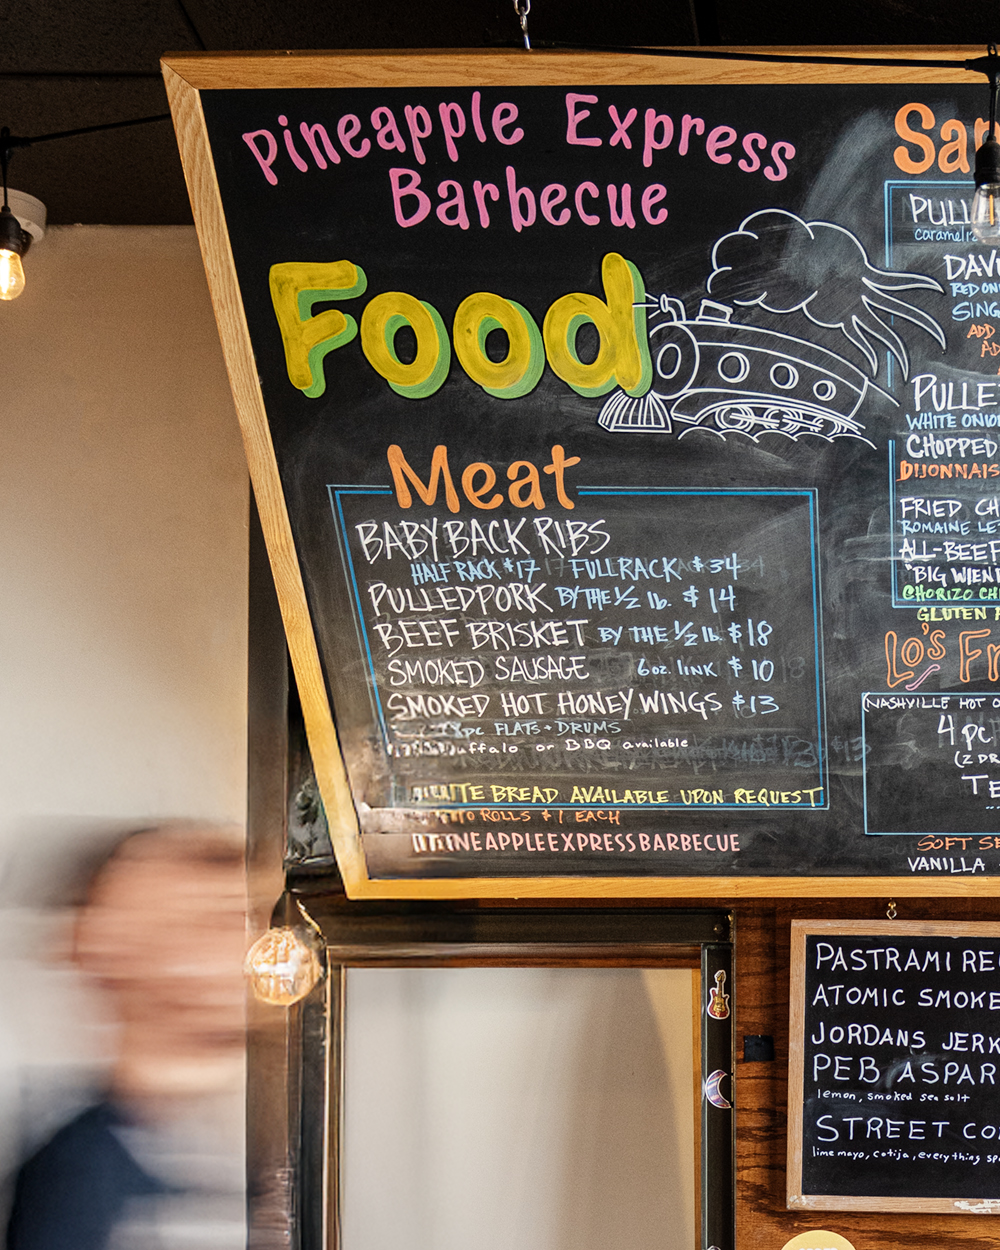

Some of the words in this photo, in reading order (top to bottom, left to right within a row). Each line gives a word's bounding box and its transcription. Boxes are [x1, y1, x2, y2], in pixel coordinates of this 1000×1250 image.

[242, 91, 525, 185] Pineapple
[565, 93, 796, 182] Express
[389, 166, 668, 232] Barbecue
[269, 252, 654, 399] Food
[906, 434, 997, 459] CHOPPED
[387, 444, 581, 514] Meat
[900, 499, 961, 518] FRIED
[356, 518, 441, 564] BABY
[444, 518, 530, 559] BACK
[534, 517, 611, 558] RIBS
[917, 607, 986, 622] GLUTEN
[388, 659, 485, 688] SMOKED
[495, 656, 590, 681] SAUSAGE
[387, 693, 490, 721] SMOKED
[501, 692, 548, 716] HOT
[557, 689, 635, 717] HONEY
[638, 692, 723, 720] WINGS
[732, 694, 780, 715] $13
[490, 784, 560, 803] BREAD
[571, 785, 672, 805] AVAILABLE
[680, 788, 724, 804] UPON
[734, 787, 824, 806] REQUEST
[918, 835, 972, 851] SOFT
[908, 857, 986, 873] VANILLA
[815, 942, 951, 972] PASTRAMI
[812, 983, 907, 1007] ATOMIC
[811, 1021, 927, 1049] JORDANS
[942, 1031, 1000, 1055] JERK
[812, 1054, 881, 1083] PEB
[817, 1089, 863, 1102] lemon,
[867, 1093, 913, 1102] smoked
[920, 1093, 939, 1102] sea
[944, 1093, 971, 1103] salt
[816, 1115, 950, 1141] STREET
